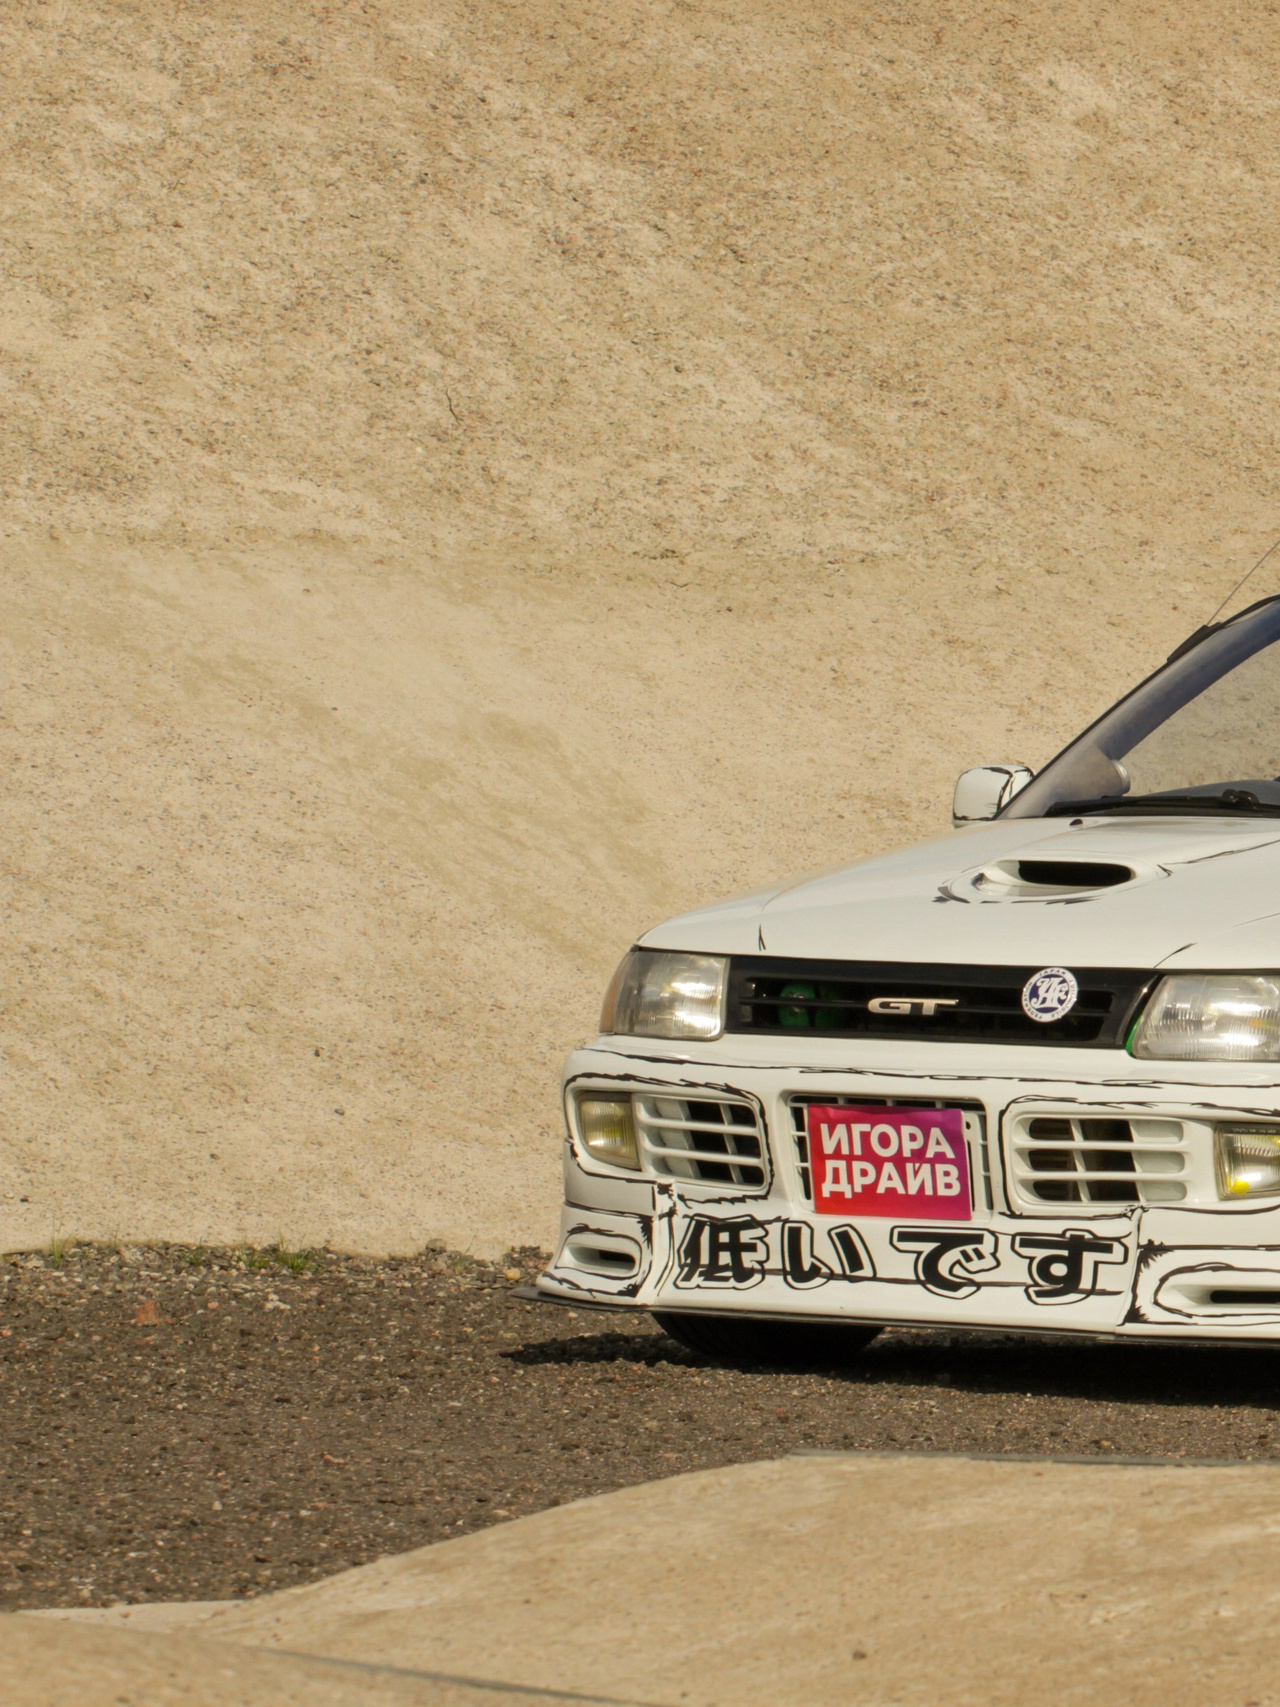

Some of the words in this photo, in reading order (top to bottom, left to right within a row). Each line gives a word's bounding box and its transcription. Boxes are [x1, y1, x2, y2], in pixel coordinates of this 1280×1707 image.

[868, 997, 959, 1015] GT
[820, 1123, 956, 1159] ИГОРА
[821, 1159, 961, 1198] ДРАЙВ
[675, 1214, 1128, 1305] 低いです
